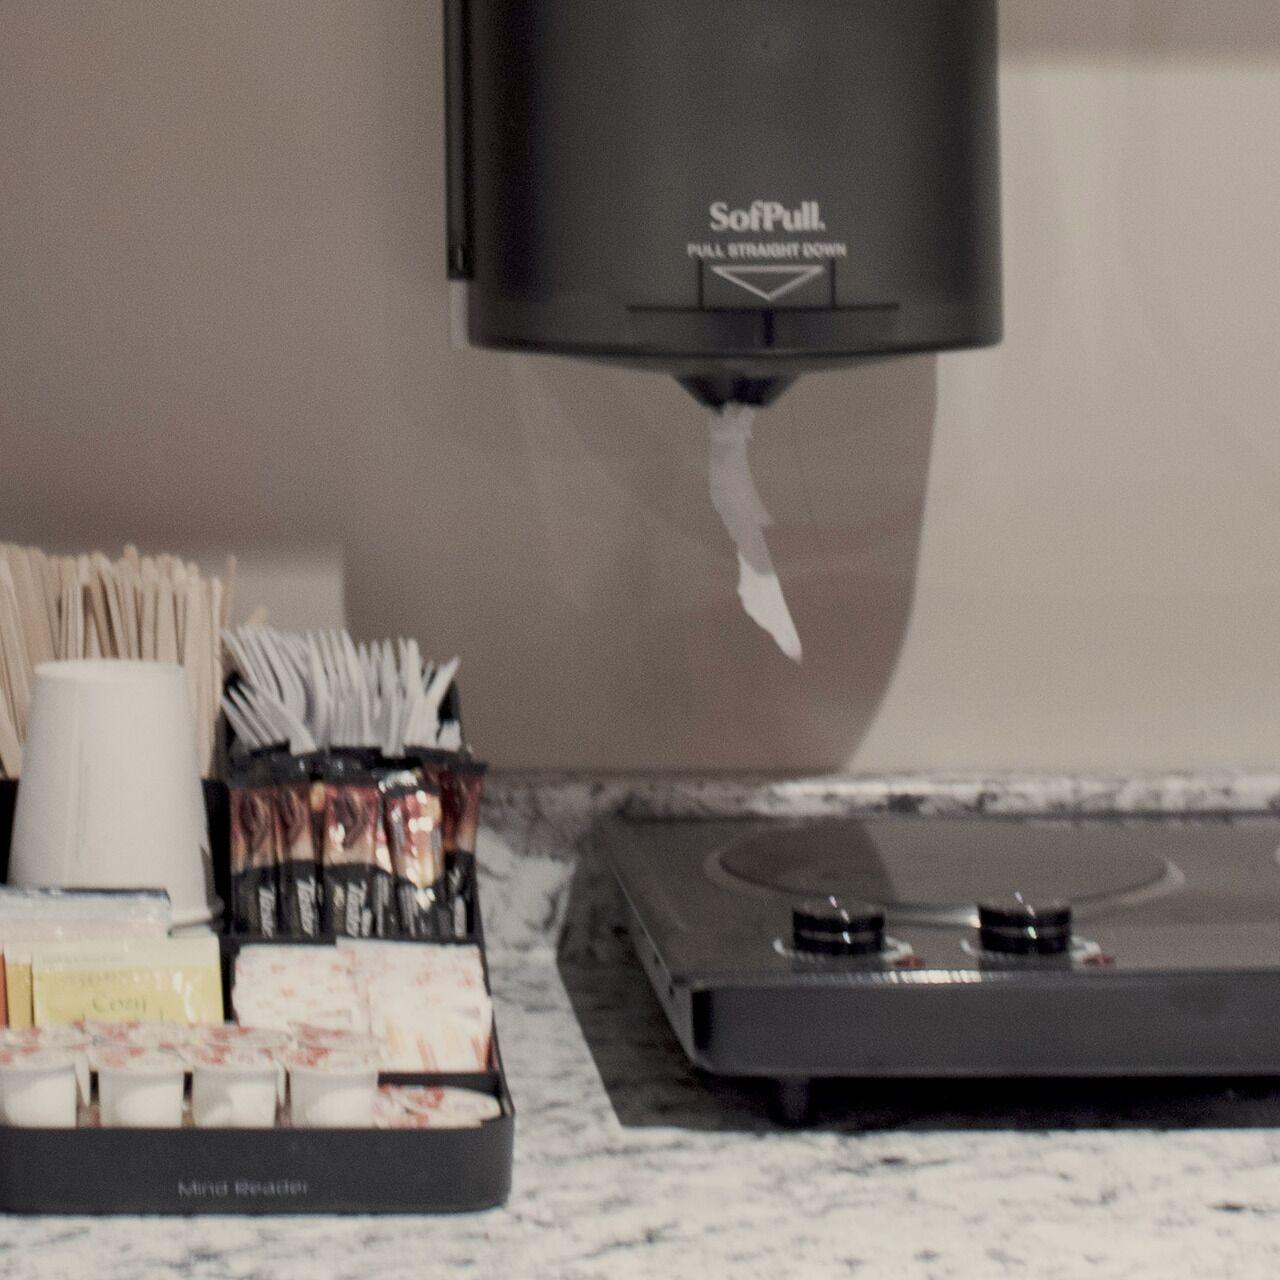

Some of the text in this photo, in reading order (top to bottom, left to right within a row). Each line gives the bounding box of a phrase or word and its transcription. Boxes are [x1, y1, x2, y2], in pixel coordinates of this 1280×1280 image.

[686, 242, 848, 258] PULL STRAIGHT DOWN
[177, 1179, 308, 1197] Mind Reader
